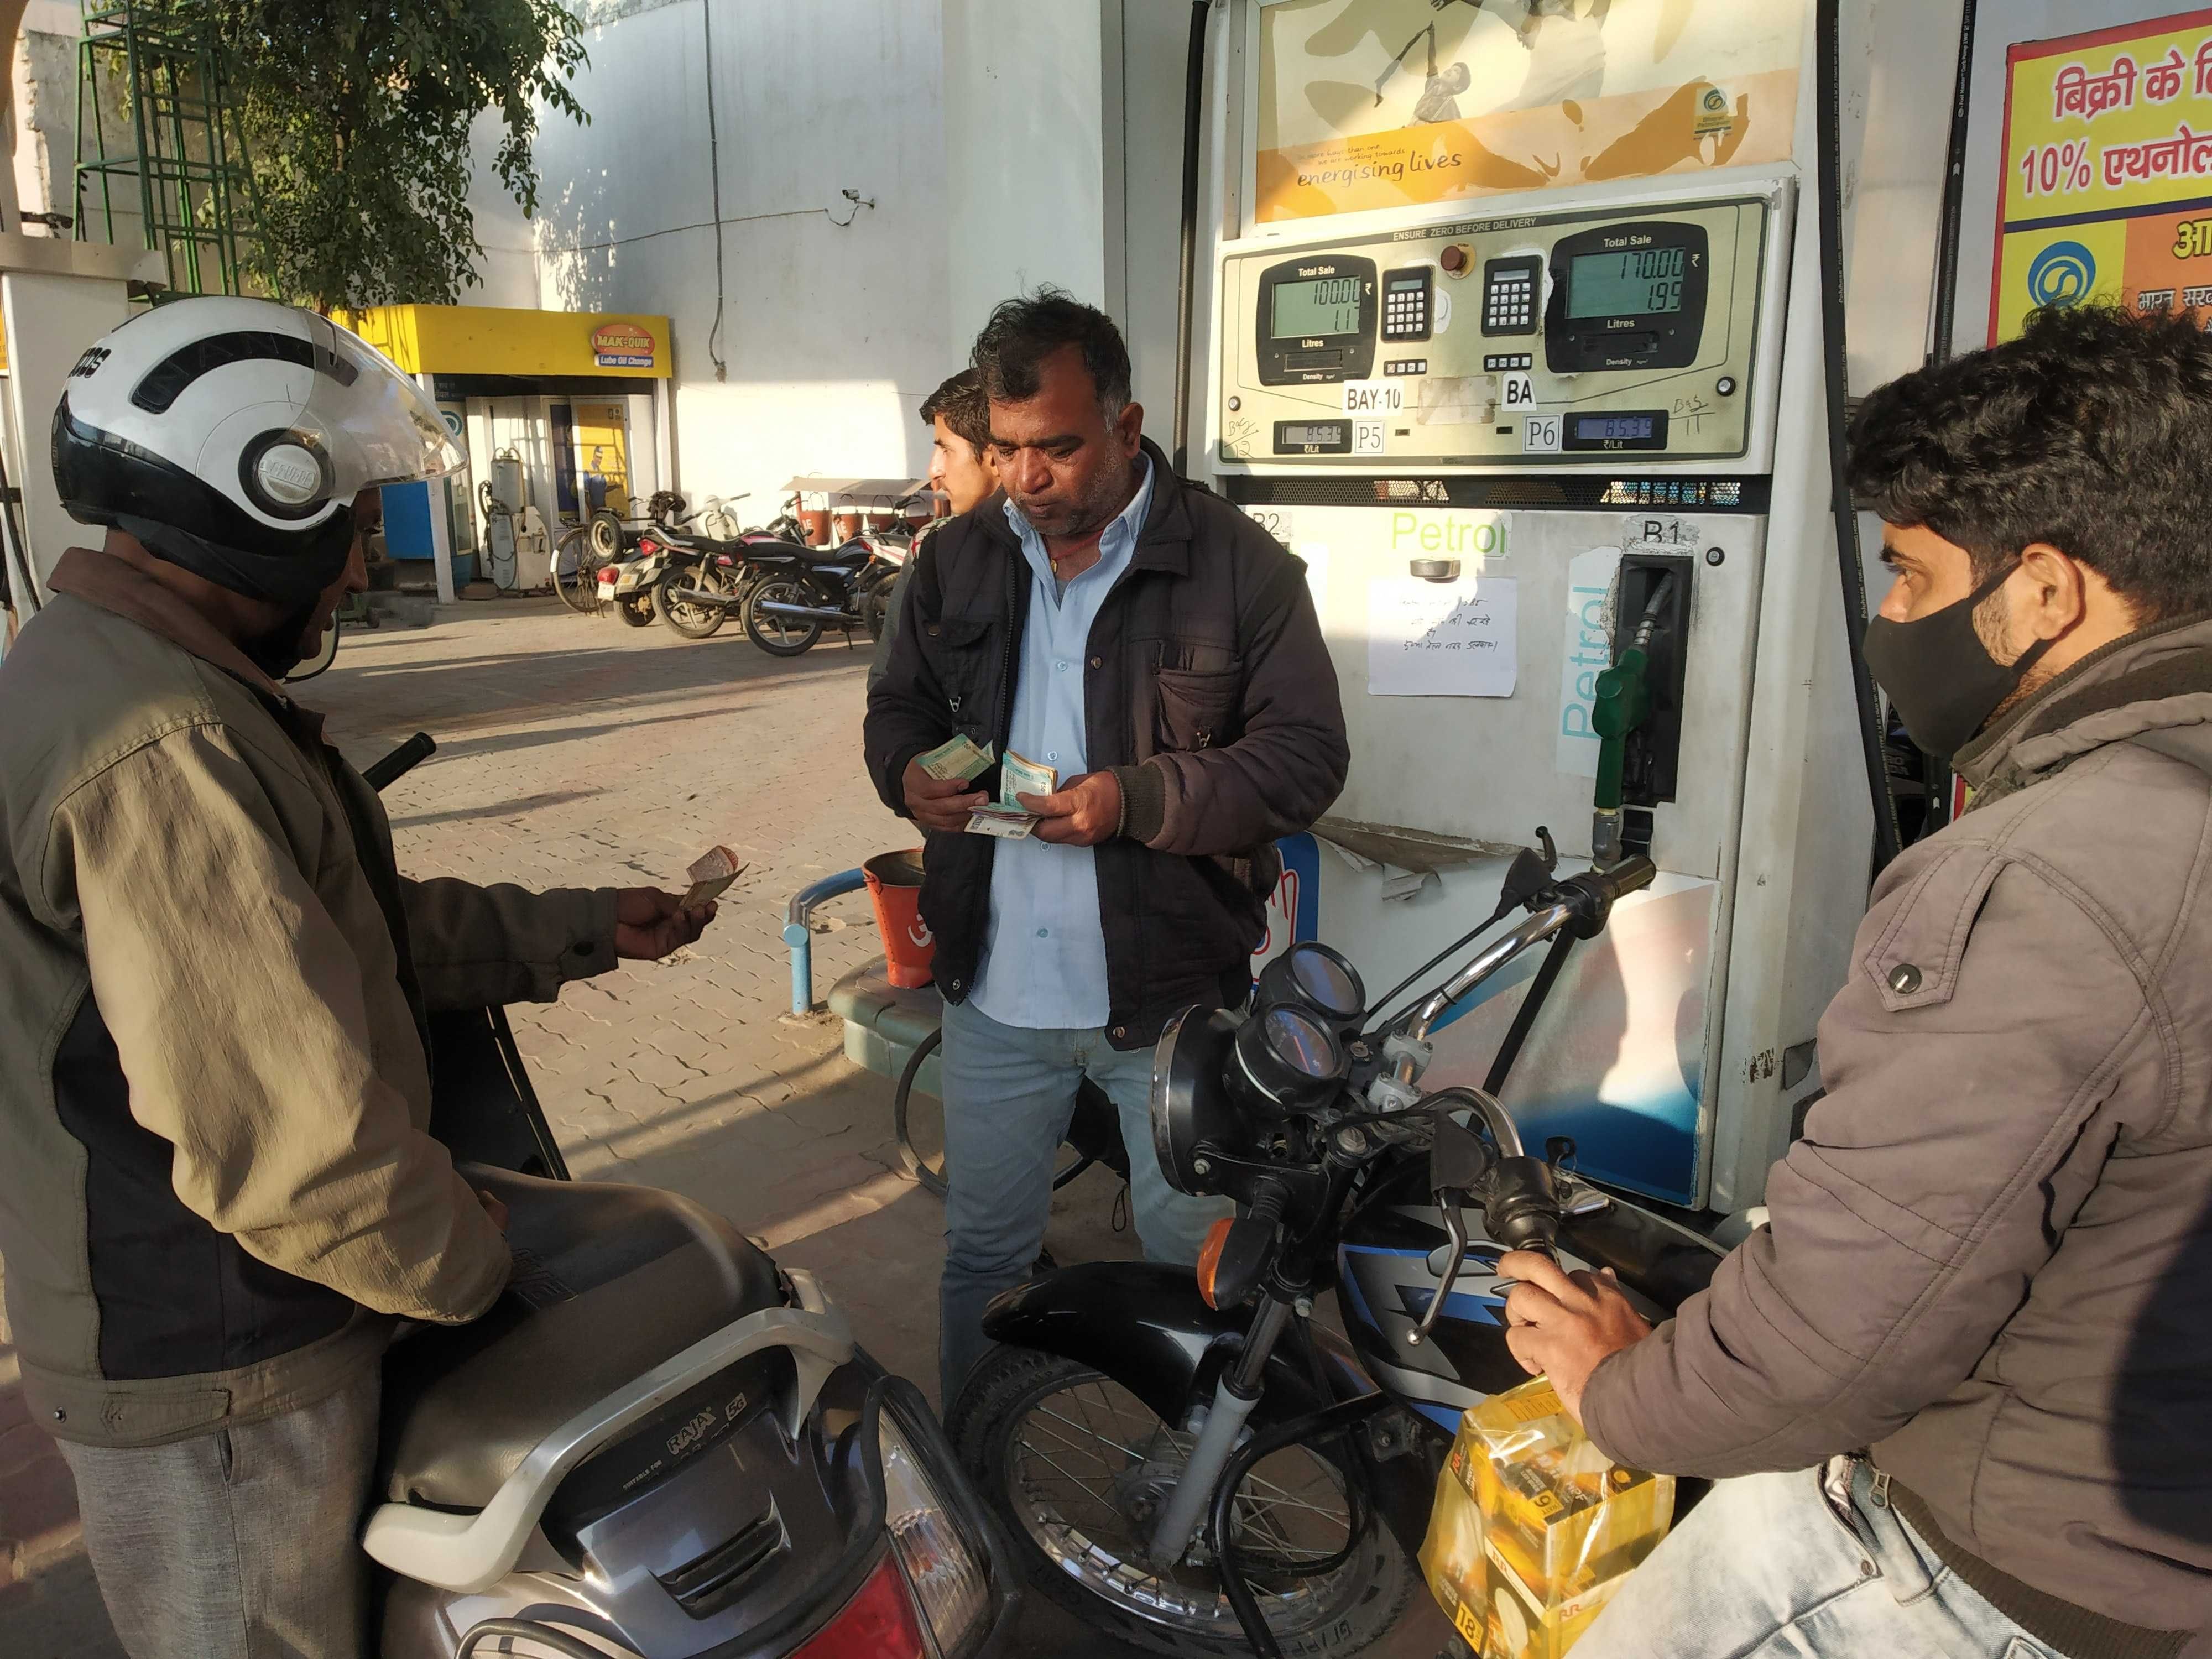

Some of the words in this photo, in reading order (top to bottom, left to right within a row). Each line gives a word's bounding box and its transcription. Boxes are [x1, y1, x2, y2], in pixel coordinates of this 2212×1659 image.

[2055, 58, 2138, 118] बिक्री
[2146, 50, 2185, 100] के
[1375, 148, 1405, 157] towards
[1297, 161, 1405, 188] energising
[1410, 150, 1462, 171] lives
[2022, 140, 2091, 194] 10%
[1393, 229, 1427, 241] ENSURE
[1430, 227, 1453, 237] ZERO
[1455, 222, 1491, 233] BEFORE
[1493, 217, 1537, 229] DELIVERY
[1604, 237, 1627, 248] Total
[1630, 234, 1652, 245] Sale
[1298, 267, 1317, 277] Total
[1318, 265, 1335, 275] Sale
[1621, 249, 1686, 280] 170.00
[1606, 319, 1635, 328] Litres
[597, 336, 650, 348] MAK-QUIK
[1302, 338, 1324, 348] Litres
[601, 356, 617, 364] Lube
[628, 357, 652, 367] Change
[1606, 358, 1632, 366] Density
[1507, 380, 1532, 404] BA
[1358, 426, 1381, 448] P5
[1528, 421, 1556, 446] P6
[1391, 512, 1505, 554] Petrol
[1644, 520, 1679, 545] B1
[1562, 587, 1610, 740] Petrol
[668, 1411, 712, 1453] RAJA
[623, 1467, 651, 1490] SUITABLE
[651, 1459, 663, 1472] FOR
[1534, 1495, 1552, 1507] 9
[1460, 1606, 1475, 1639] 18
